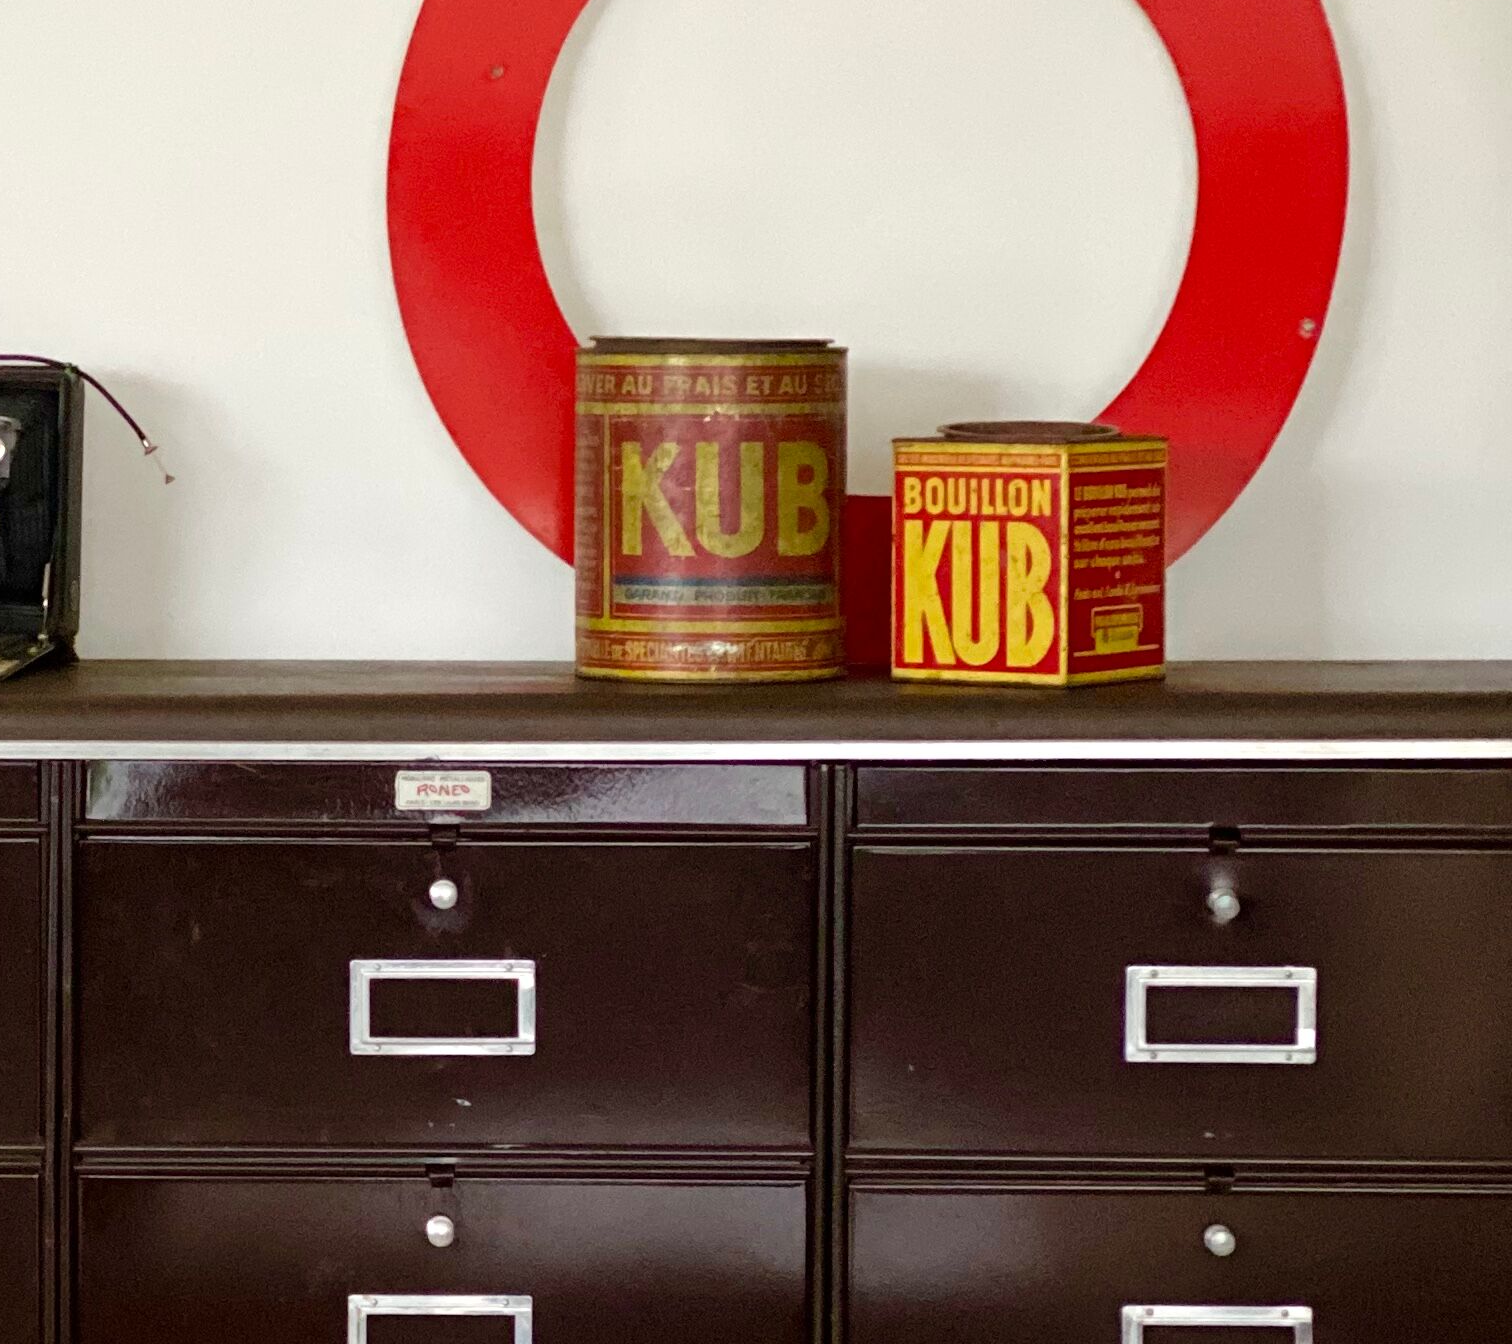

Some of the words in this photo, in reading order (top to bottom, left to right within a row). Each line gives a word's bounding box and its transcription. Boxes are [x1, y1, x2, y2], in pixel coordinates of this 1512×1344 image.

[621, 374, 653, 395] AU
[663, 374, 737, 397] FRAIS
[745, 375, 773, 396] ET
[779, 374, 808, 395] AU
[621, 441, 830, 557] KUB
[904, 520, 1055, 667] KUB
[417, 783, 471, 797] RONEO
